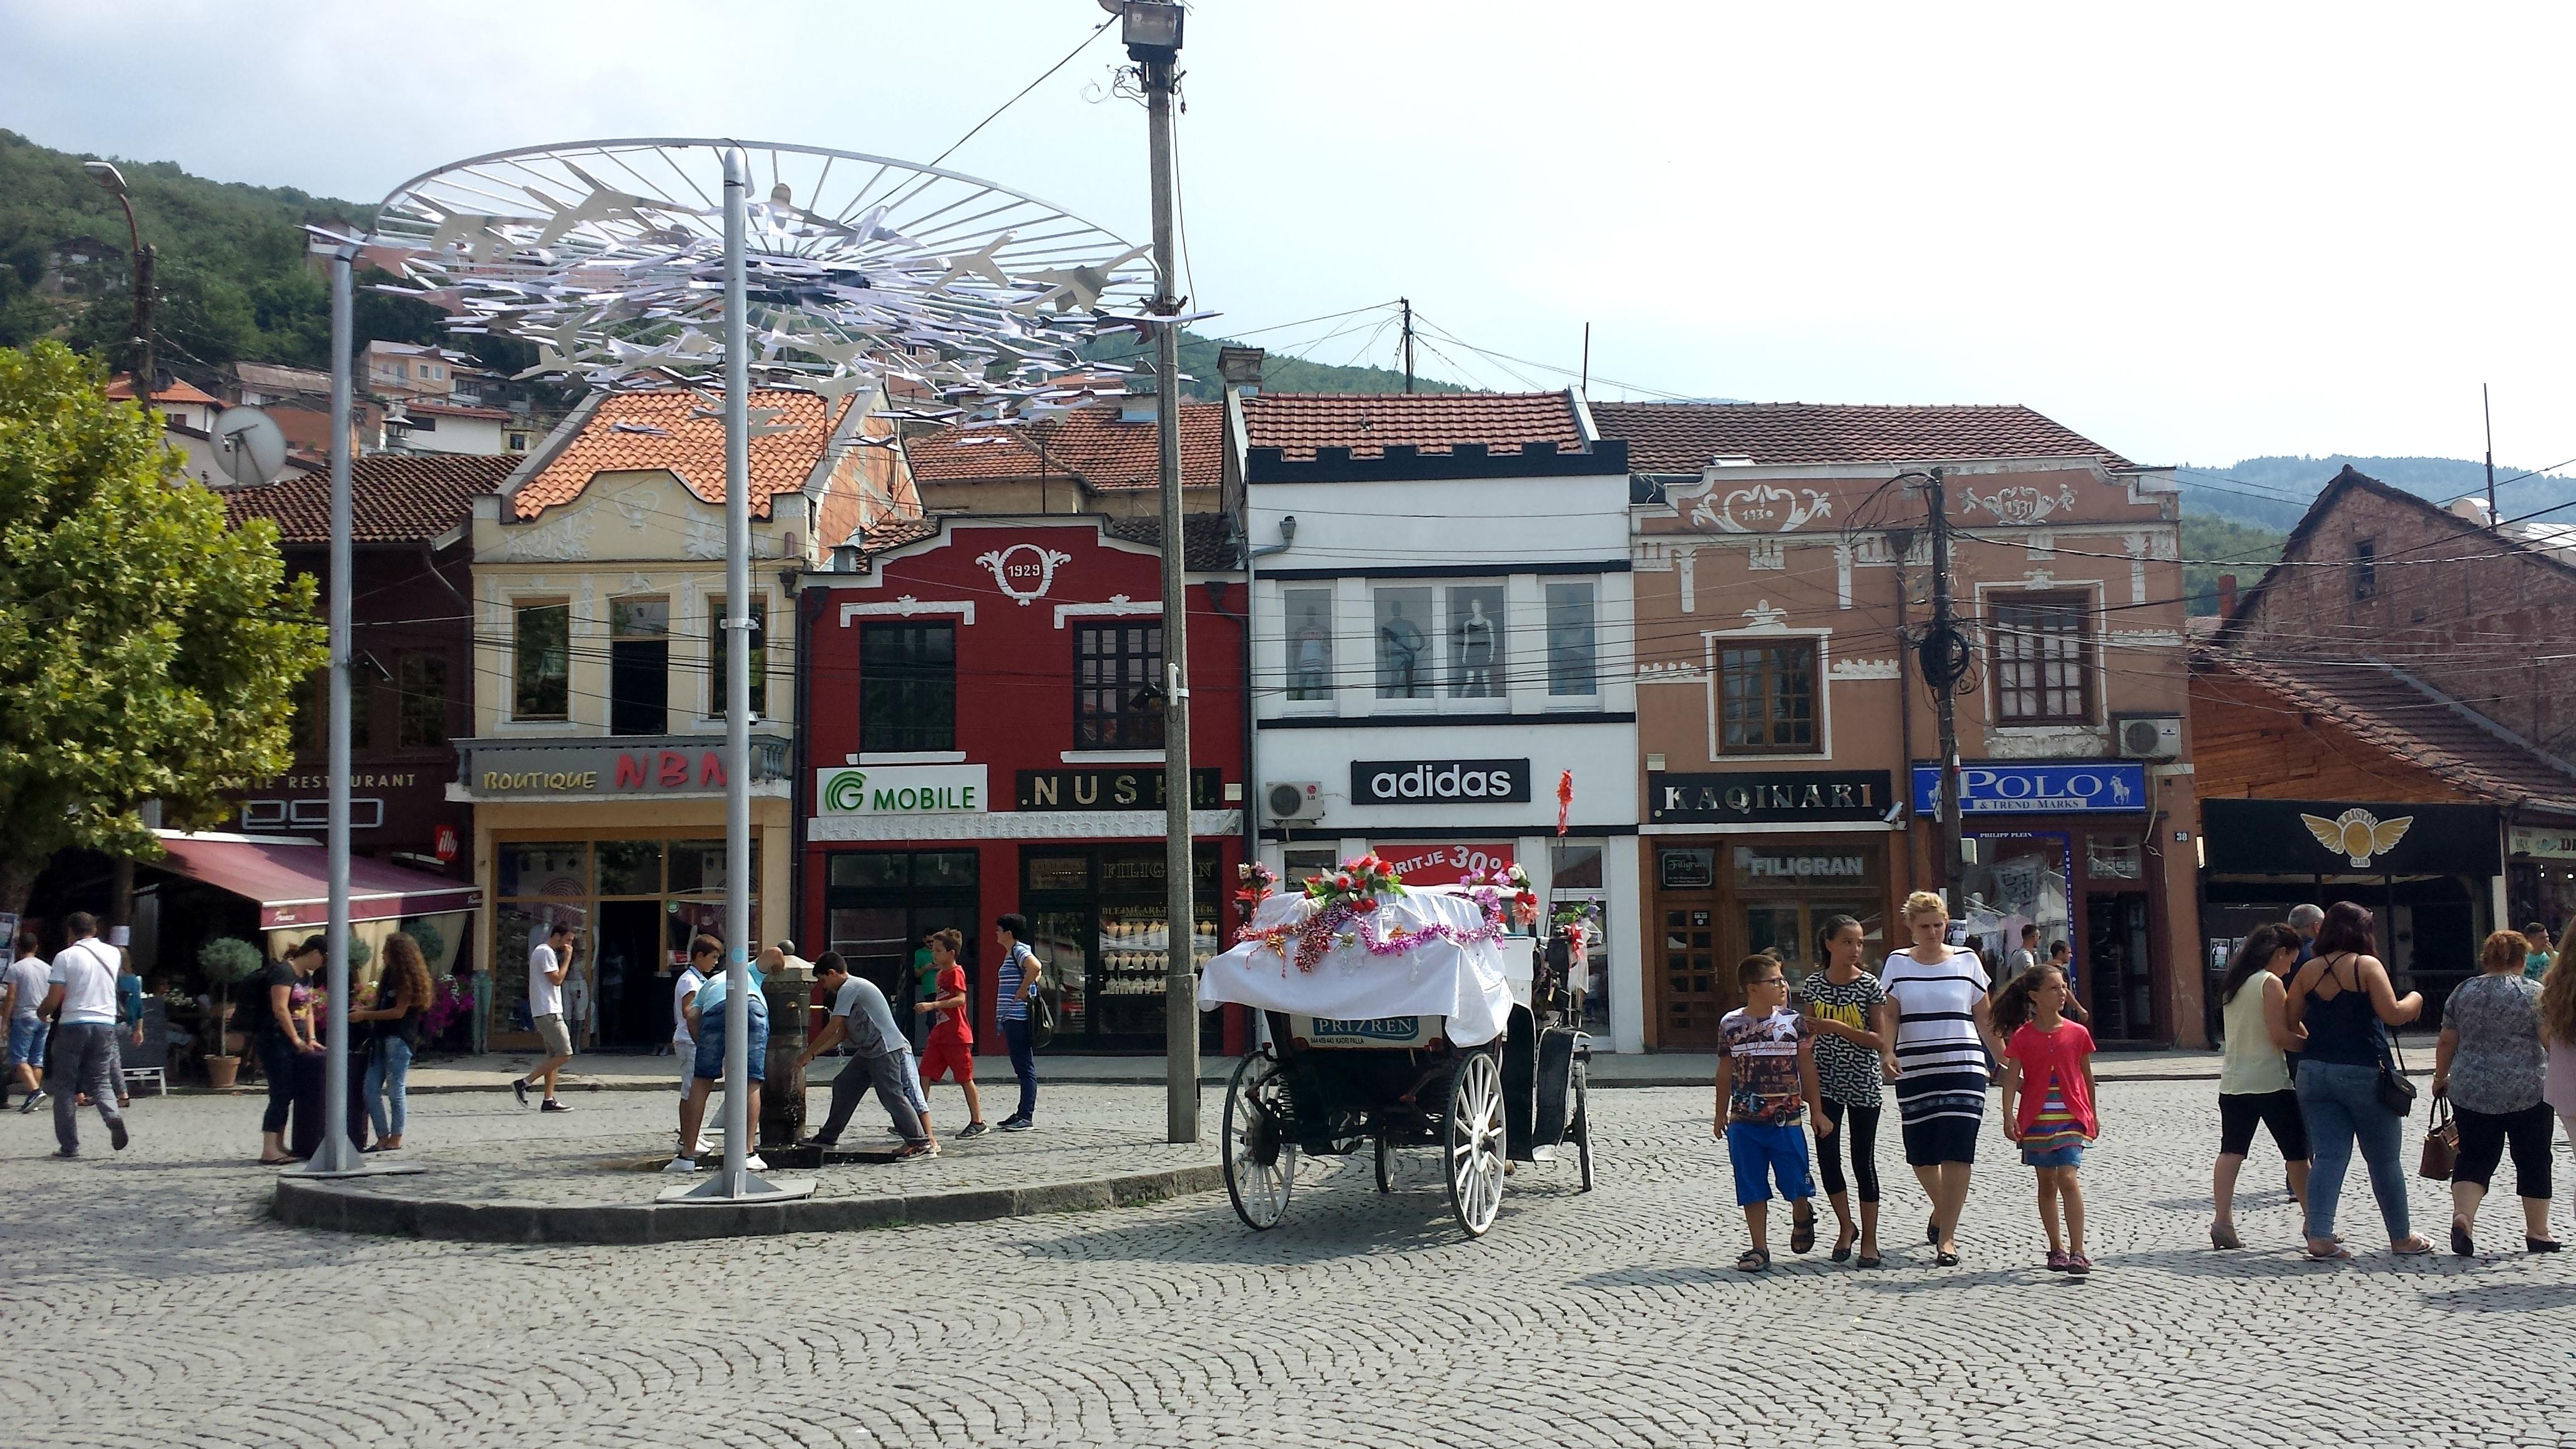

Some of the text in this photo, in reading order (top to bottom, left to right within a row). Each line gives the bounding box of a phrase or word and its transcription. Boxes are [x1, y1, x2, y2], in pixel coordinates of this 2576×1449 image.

[1007, 564, 1040, 577] 1929
[482, 751, 728, 790] BOUTIQUE NBN
[288, 774, 416, 789] RESTURANT
[1372, 764, 1511, 798] adidas
[1958, 770, 2103, 799] POLO
[874, 786, 975, 811] MOBILE
[1663, 783, 1873, 814] KAQINARI
[1979, 799, 2079, 809] & TREND MARKS
[438, 829, 457, 858] illy
[2176, 832, 2188, 841] 38
[1103, 862, 1213, 879] FILIGN
[1389, 850, 1445, 876] BRITJE
[1750, 857, 1864, 876] FILIGRAN
[2351, 858, 2369, 867] CLUB
[1317, 1018, 1413, 1033] PRIZREN
